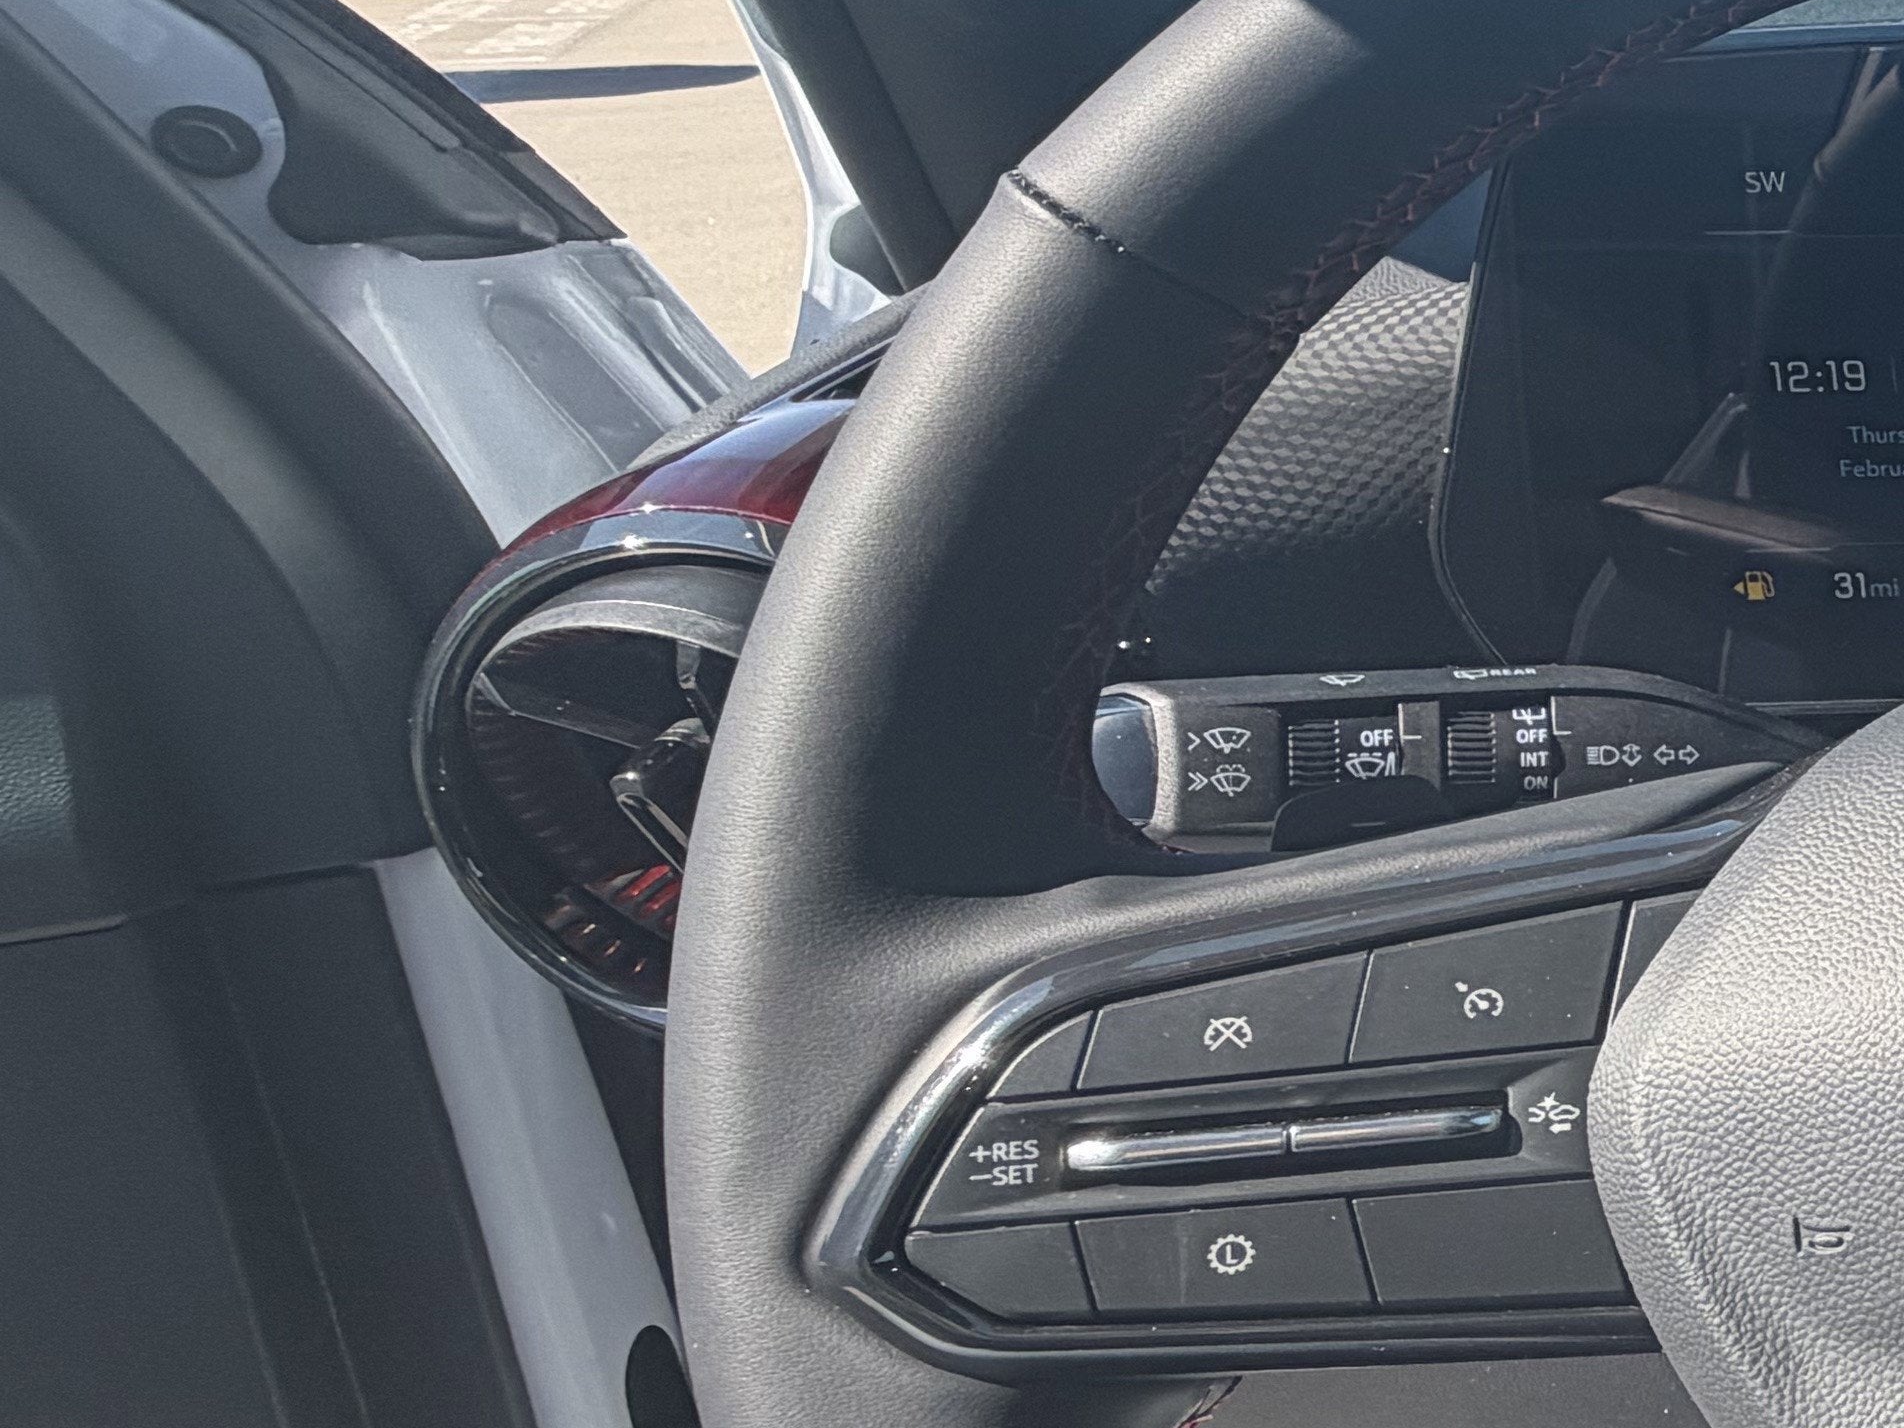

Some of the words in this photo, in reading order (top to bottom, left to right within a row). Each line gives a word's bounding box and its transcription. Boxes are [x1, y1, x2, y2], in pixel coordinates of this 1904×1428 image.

[1744, 171, 1785, 193] SW
[1770, 359, 1866, 392] 12:19
[1360, 729, 1394, 748] OFF
[1515, 728, 1548, 744] OFF
[1520, 751, 1549, 768] INT
[1523, 775, 1548, 790] ON
